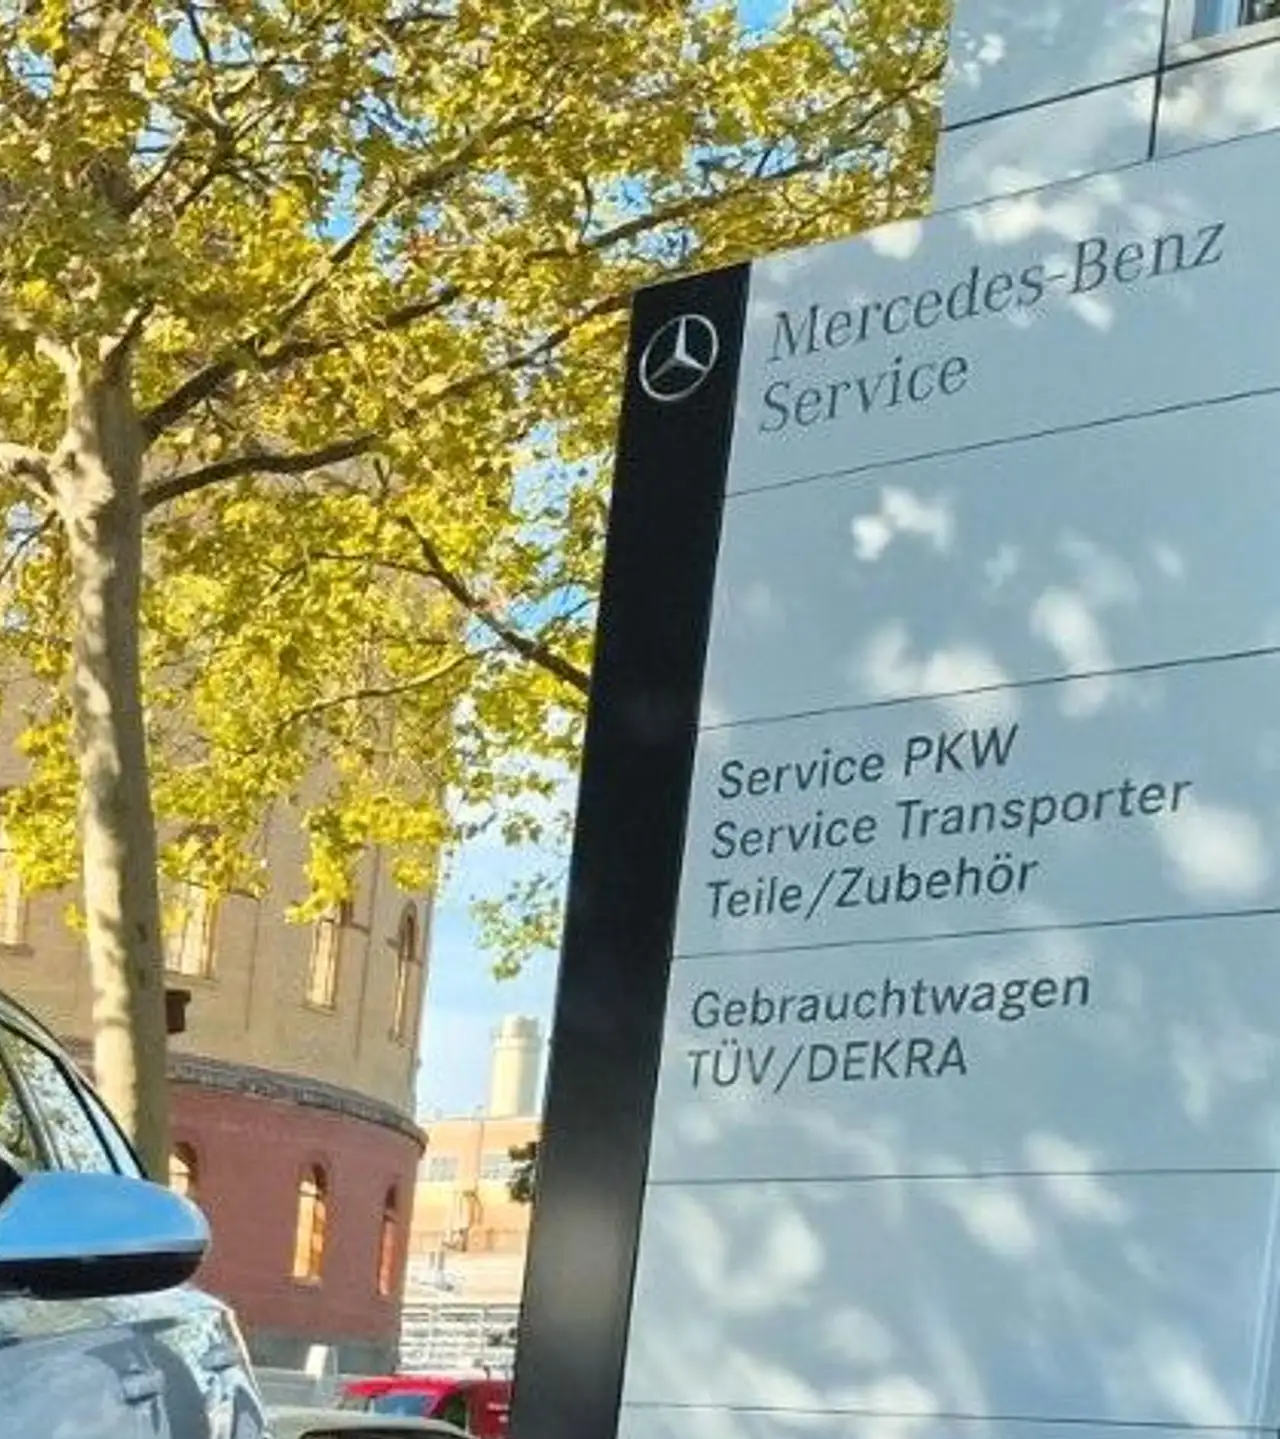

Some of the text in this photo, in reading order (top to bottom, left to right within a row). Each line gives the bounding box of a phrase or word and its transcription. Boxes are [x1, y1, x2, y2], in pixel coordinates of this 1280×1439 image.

[767, 220, 1226, 362] Mercedes-Benz
[760, 351, 967, 433] Service
[719, 724, 1017, 799] Service PKW
[711, 777, 1192, 860] Service Transporter
[706, 853, 1038, 920] Teile/Zubehör
[692, 974, 1090, 1028] Gebrauchtwagen
[688, 1036, 967, 1093] TÜV/DEKRA
